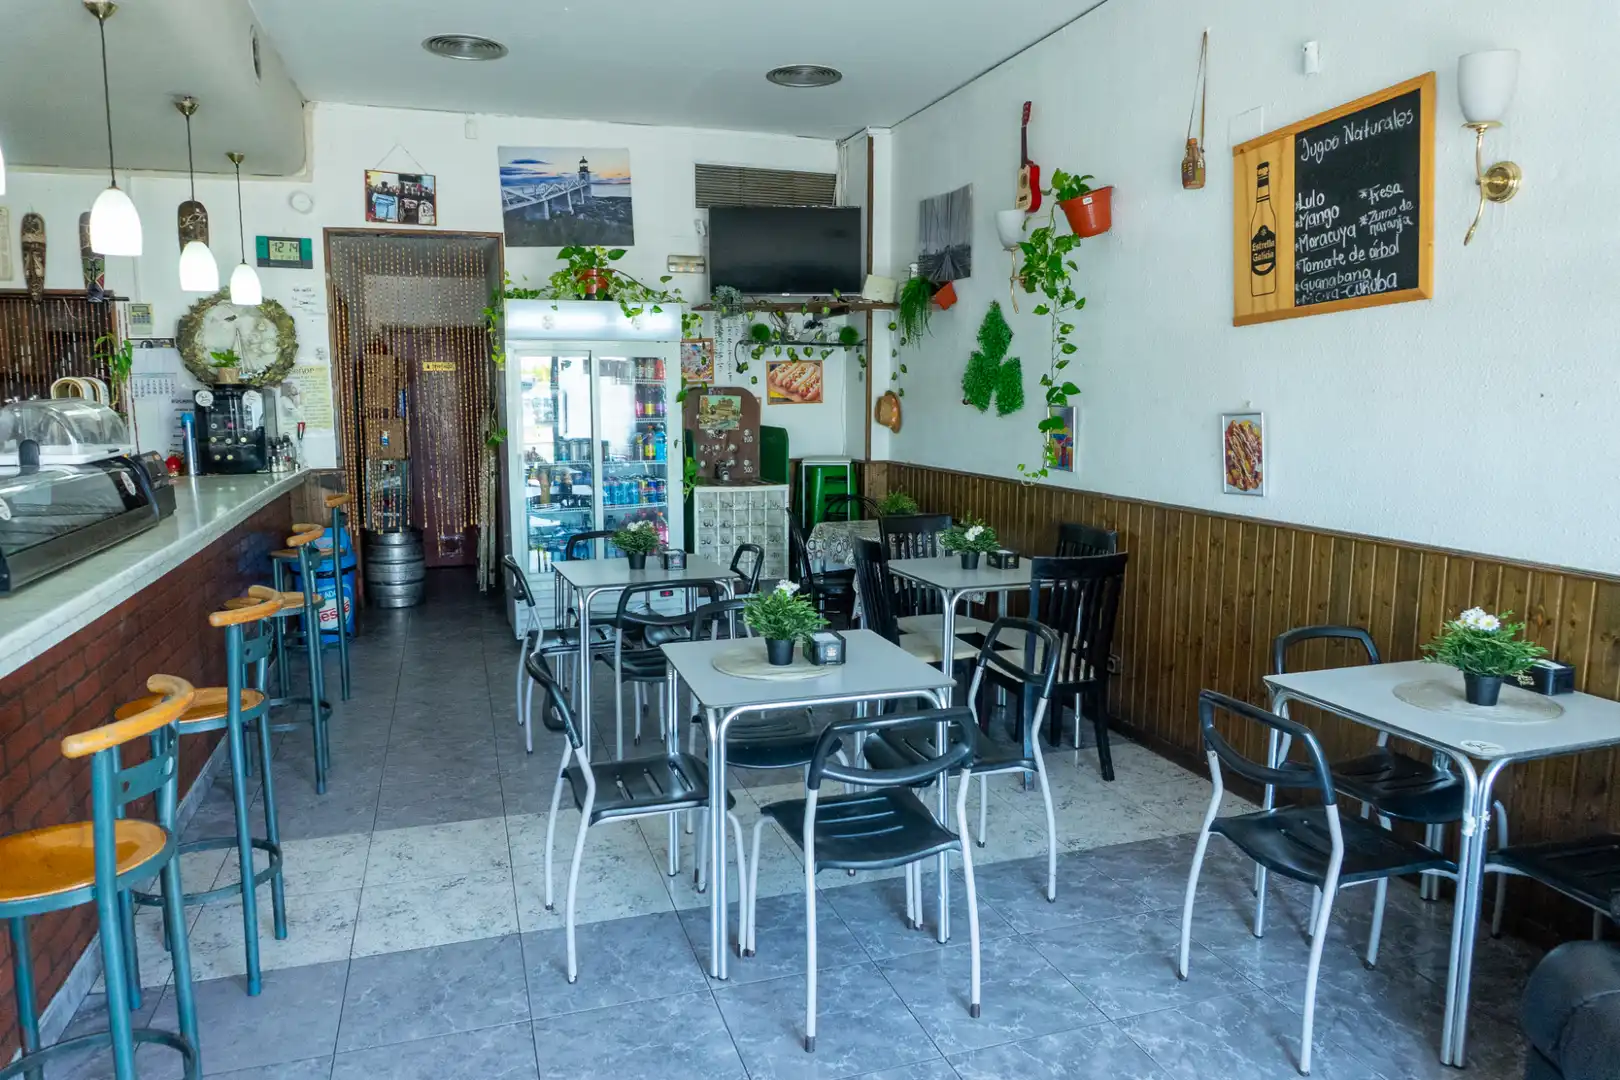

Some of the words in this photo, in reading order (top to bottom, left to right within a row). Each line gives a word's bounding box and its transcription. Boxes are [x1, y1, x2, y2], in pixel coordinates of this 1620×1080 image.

[1343, 107, 1414, 145] Naturales
[1298, 189, 1326, 210] Lulo
[1368, 183, 1404, 205] Fresa
[1299, 205, 1340, 231] Mango
[1367, 206, 1397, 225] Zumo
[1399, 198, 1414, 211] de
[1369, 215, 1414, 236] naranja
[1299, 248, 1346, 274] Tomate
[1349, 244, 1366, 261] de
[1300, 267, 1372, 293] Guanabana
